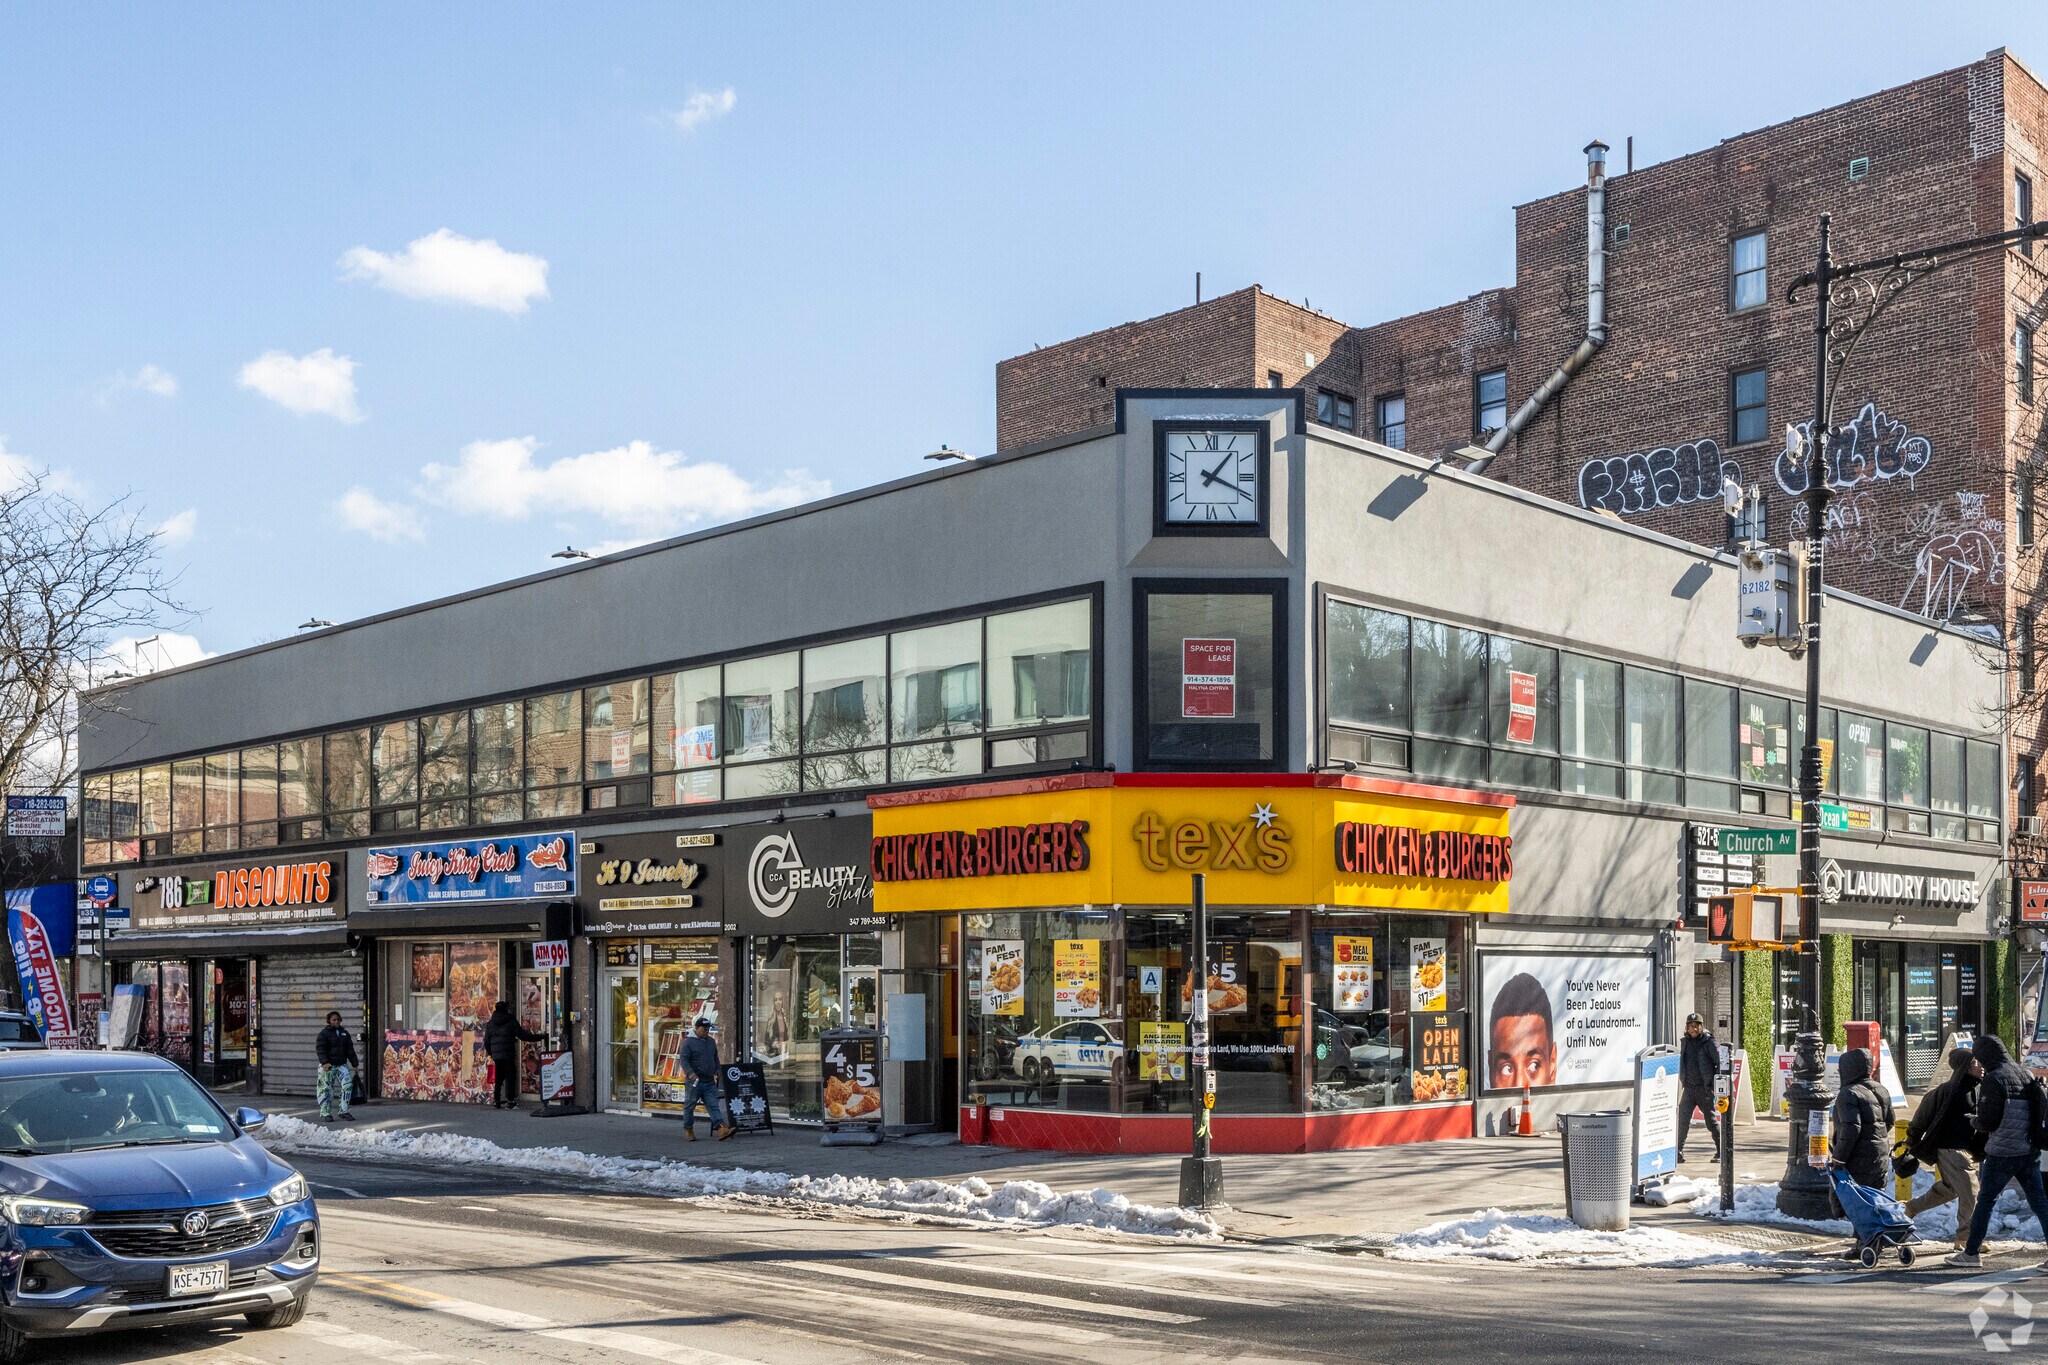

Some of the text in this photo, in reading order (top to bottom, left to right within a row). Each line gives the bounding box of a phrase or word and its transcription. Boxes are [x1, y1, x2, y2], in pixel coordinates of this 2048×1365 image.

[1848, 723, 1871, 746] OPEN
[680, 742, 713, 768] TAX
[581, 844, 594, 853] 2004
[1726, 833, 1790, 852] Church Av
[870, 820, 1086, 883] CHICKEN & BURGERS
[1340, 820, 1513, 882] CHICKEN & BURGERS
[408, 851, 443, 885] Juicy
[443, 848, 481, 883] King
[481, 843, 516, 872] Crab
[505, 875, 521, 883] Express
[596, 858, 698, 889] K 9 Jewelry
[789, 865, 857, 890] BEAUTY
[158, 876, 183, 909] 786
[214, 861, 331, 909] DISCOUNTS
[1844, 869, 1980, 904] LAUNDRY HOUSE
[460, 889, 486, 898] RESTAURANT
[231, 912, 257, 921] ELECTRONICS
[259, 911, 271, 920] PARTY
[272, 910, 290, 920] SUPPLIES
[724, 923, 737, 931] 2002
[535, 944, 550, 960] ATM
[985, 943, 1006, 956] FAM
[1353, 946, 1369, 955] MEAL
[1413, 941, 1431, 953] FAM
[1422, 947, 1443, 960] FEST
[996, 949, 1021, 962] FEST
[1144, 971, 1157, 985] A
[1565, 979, 1621, 992] You've Never
[1566, 998, 1622, 1011] Been Jealous
[1566, 1016, 1641, 1029] of a Laundromat...
[1423, 1028, 1460, 1047] OPEN
[1566, 1035, 1608, 1048] Until Now
[825, 1044, 847, 1067] 4
[1217, 1045, 1230, 1055] Lard,
[1231, 1045, 1239, 1053] We
[1240, 1045, 1249, 1053] Use
[1250, 1045, 1264, 1053] 100%
[1264, 1045, 1287, 1053] Lard-free
[1423, 1046, 1460, 1065] LATE
[558, 1090, 573, 1098] SALE
[174, 1270, 224, 1289] KSE 7577
